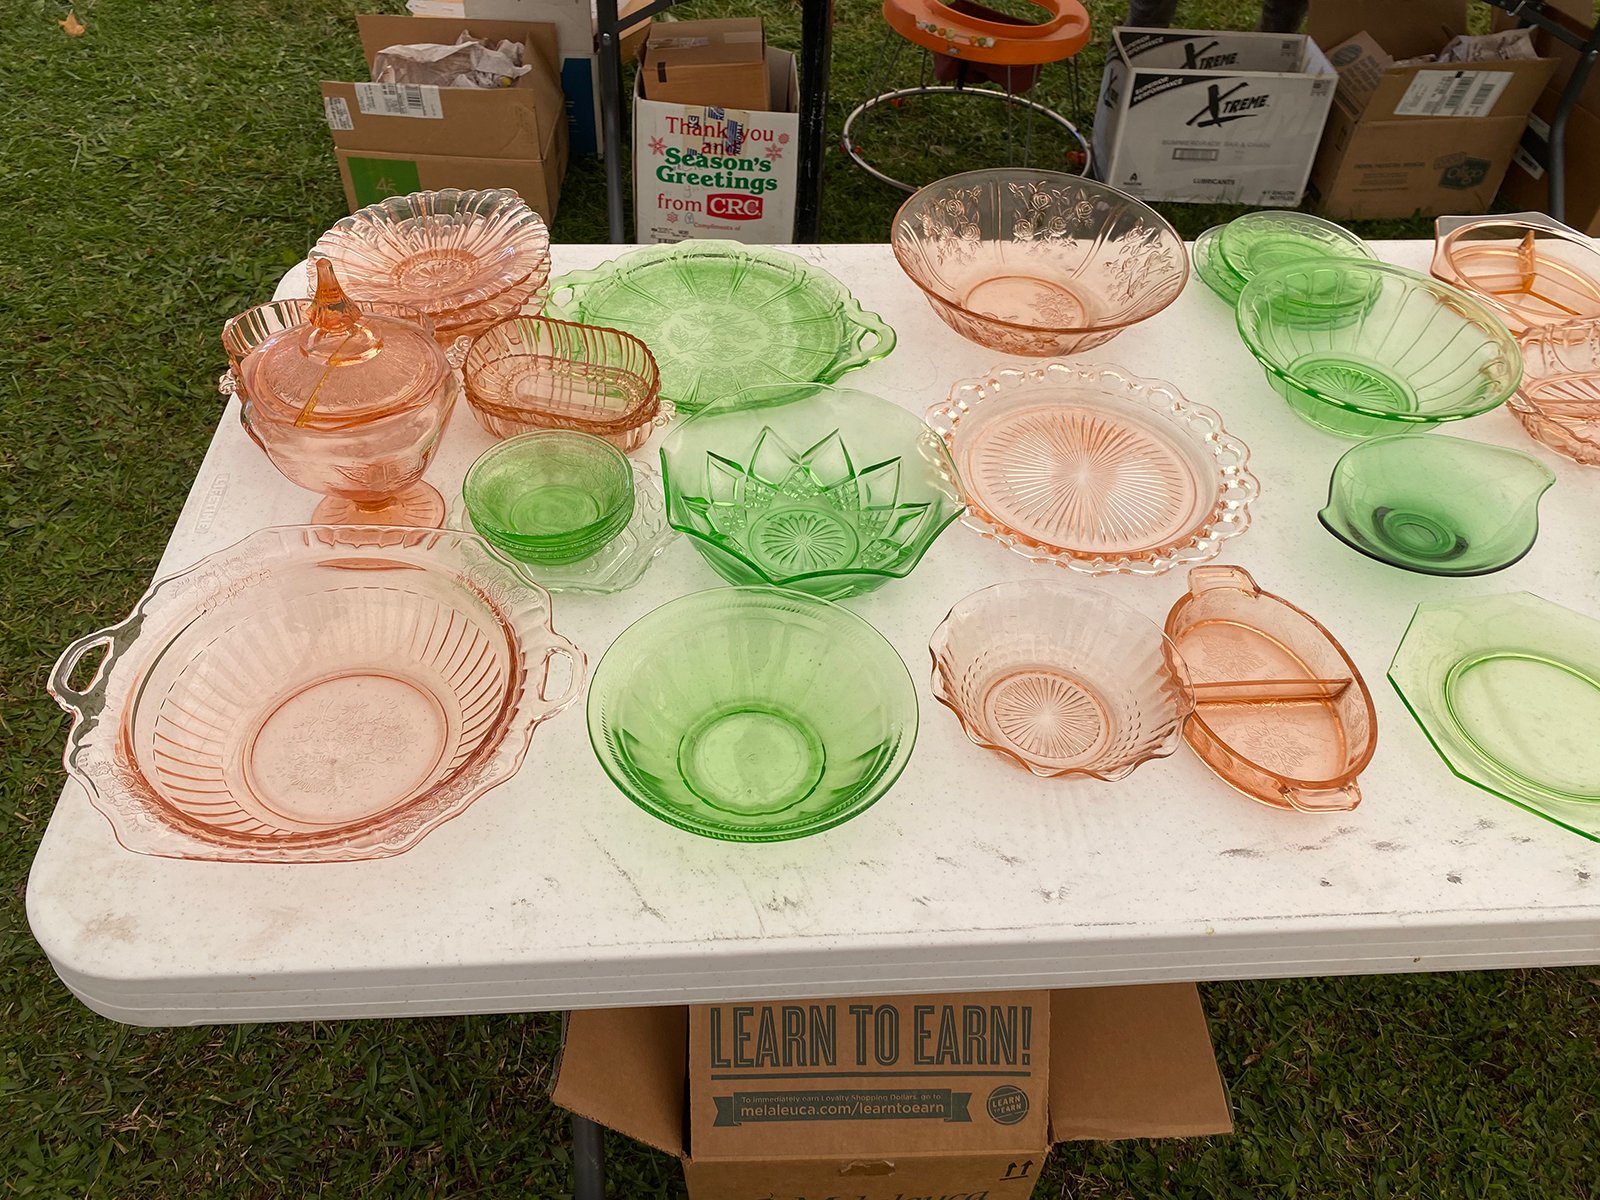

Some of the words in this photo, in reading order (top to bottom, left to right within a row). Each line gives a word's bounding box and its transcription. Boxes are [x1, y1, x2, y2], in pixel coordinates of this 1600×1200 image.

[1133, 78, 1184, 102] PERFORMANCE
[1185, 82, 1270, 128] XTREME
[665, 116, 728, 139] Thank
[740, 129, 774, 144] you
[665, 147, 772, 172] Season's
[701, 141, 737, 157] and
[656, 165, 778, 195] Greetings
[1193, 178, 1235, 186] LUBRICANTS
[657, 193, 702, 213] from
[709, 197, 760, 216] CRC
[710, 1004, 837, 1069] LEARN
[849, 1003, 900, 1067] TO
[913, 1004, 1032, 1066] EARN!
[741, 1101, 944, 1117] melaleuca.com/learntoearn
[742, 1095, 751, 1104] To
[753, 1094, 800, 1104] immediately
[820, 1094, 849, 1104] Loyalty
[850, 1094, 887, 1104] Shopping
[919, 1094, 930, 1102] go
[992, 1095, 1021, 1109] LEARN
[1001, 1103, 1021, 1114] EARN
